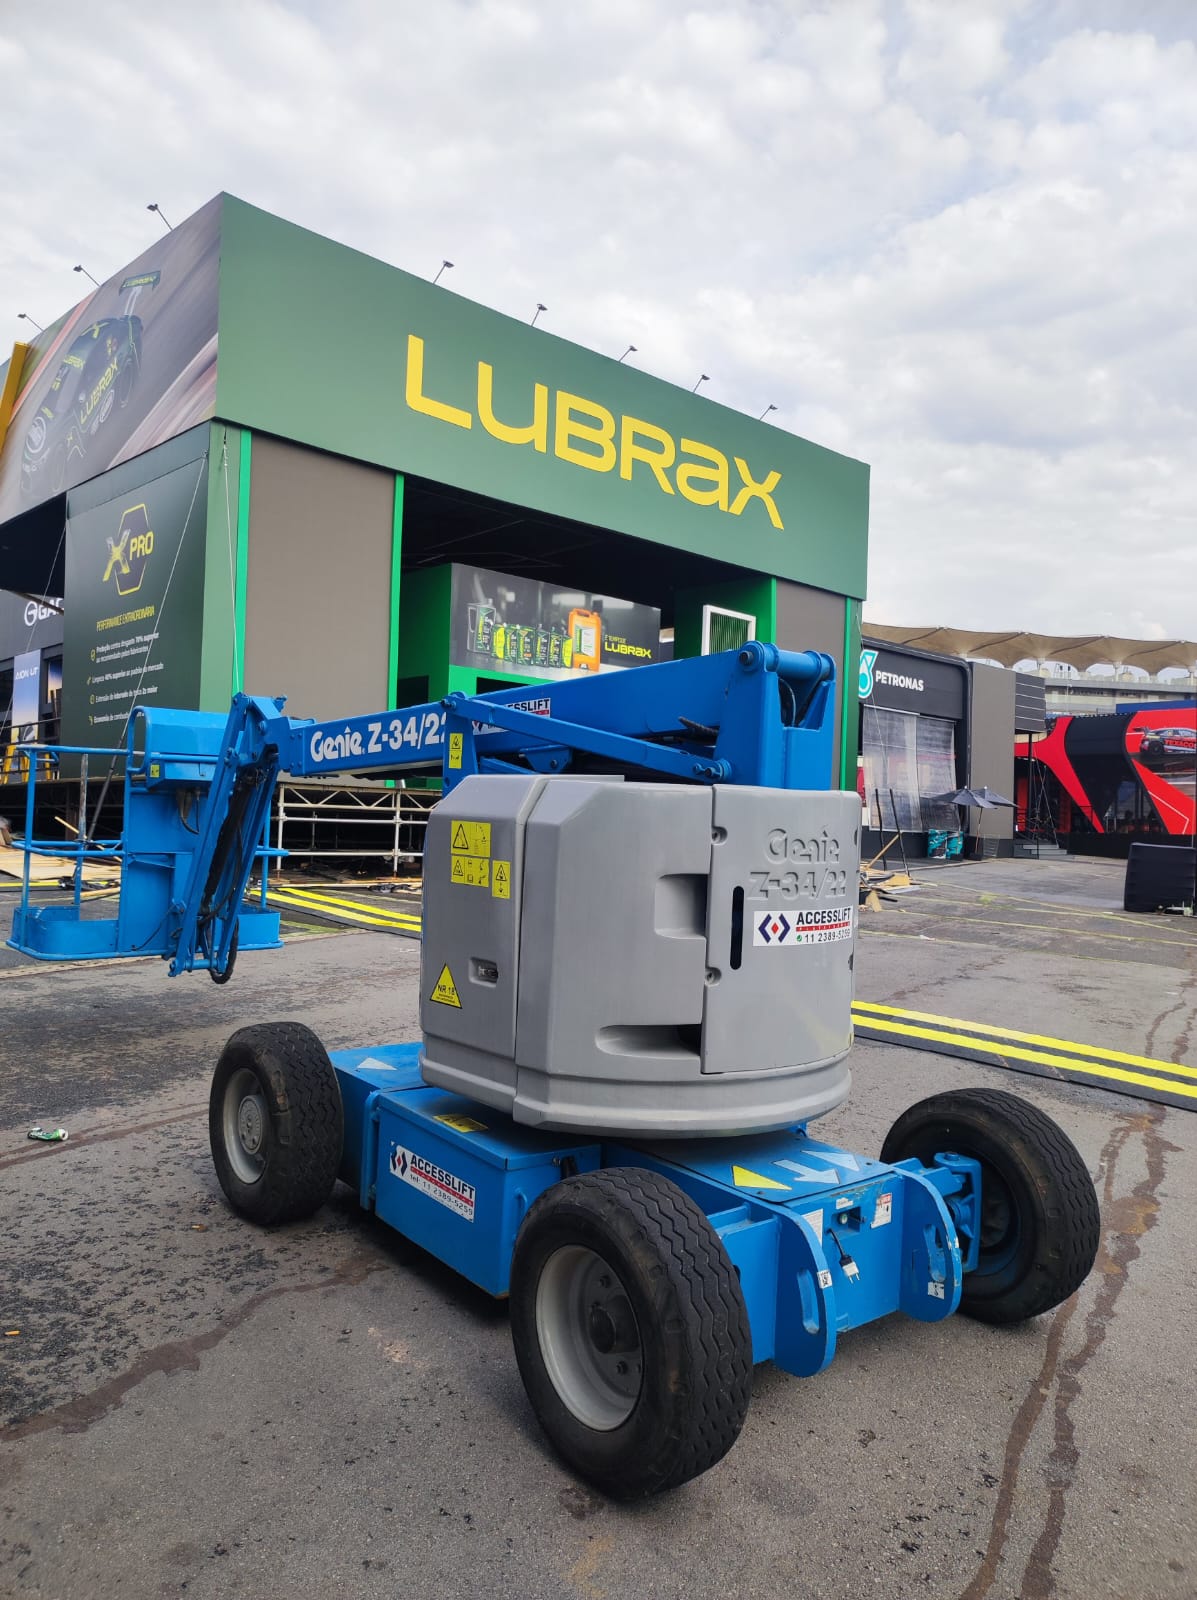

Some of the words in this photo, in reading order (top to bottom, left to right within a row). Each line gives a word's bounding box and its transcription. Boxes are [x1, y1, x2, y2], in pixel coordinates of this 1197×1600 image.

[129, 531, 154, 560] PRO
[875, 670, 924, 692] PETRONAS
[310, 726, 363, 762] Genie
[765, 826, 840, 864] Genie
[746, 867, 847, 900] Z-34/22
[796, 907, 851, 925] ACCESSLIFT
[437, 984, 447, 994] NR
[410, 1154, 475, 1200] ACCESSLIFT
